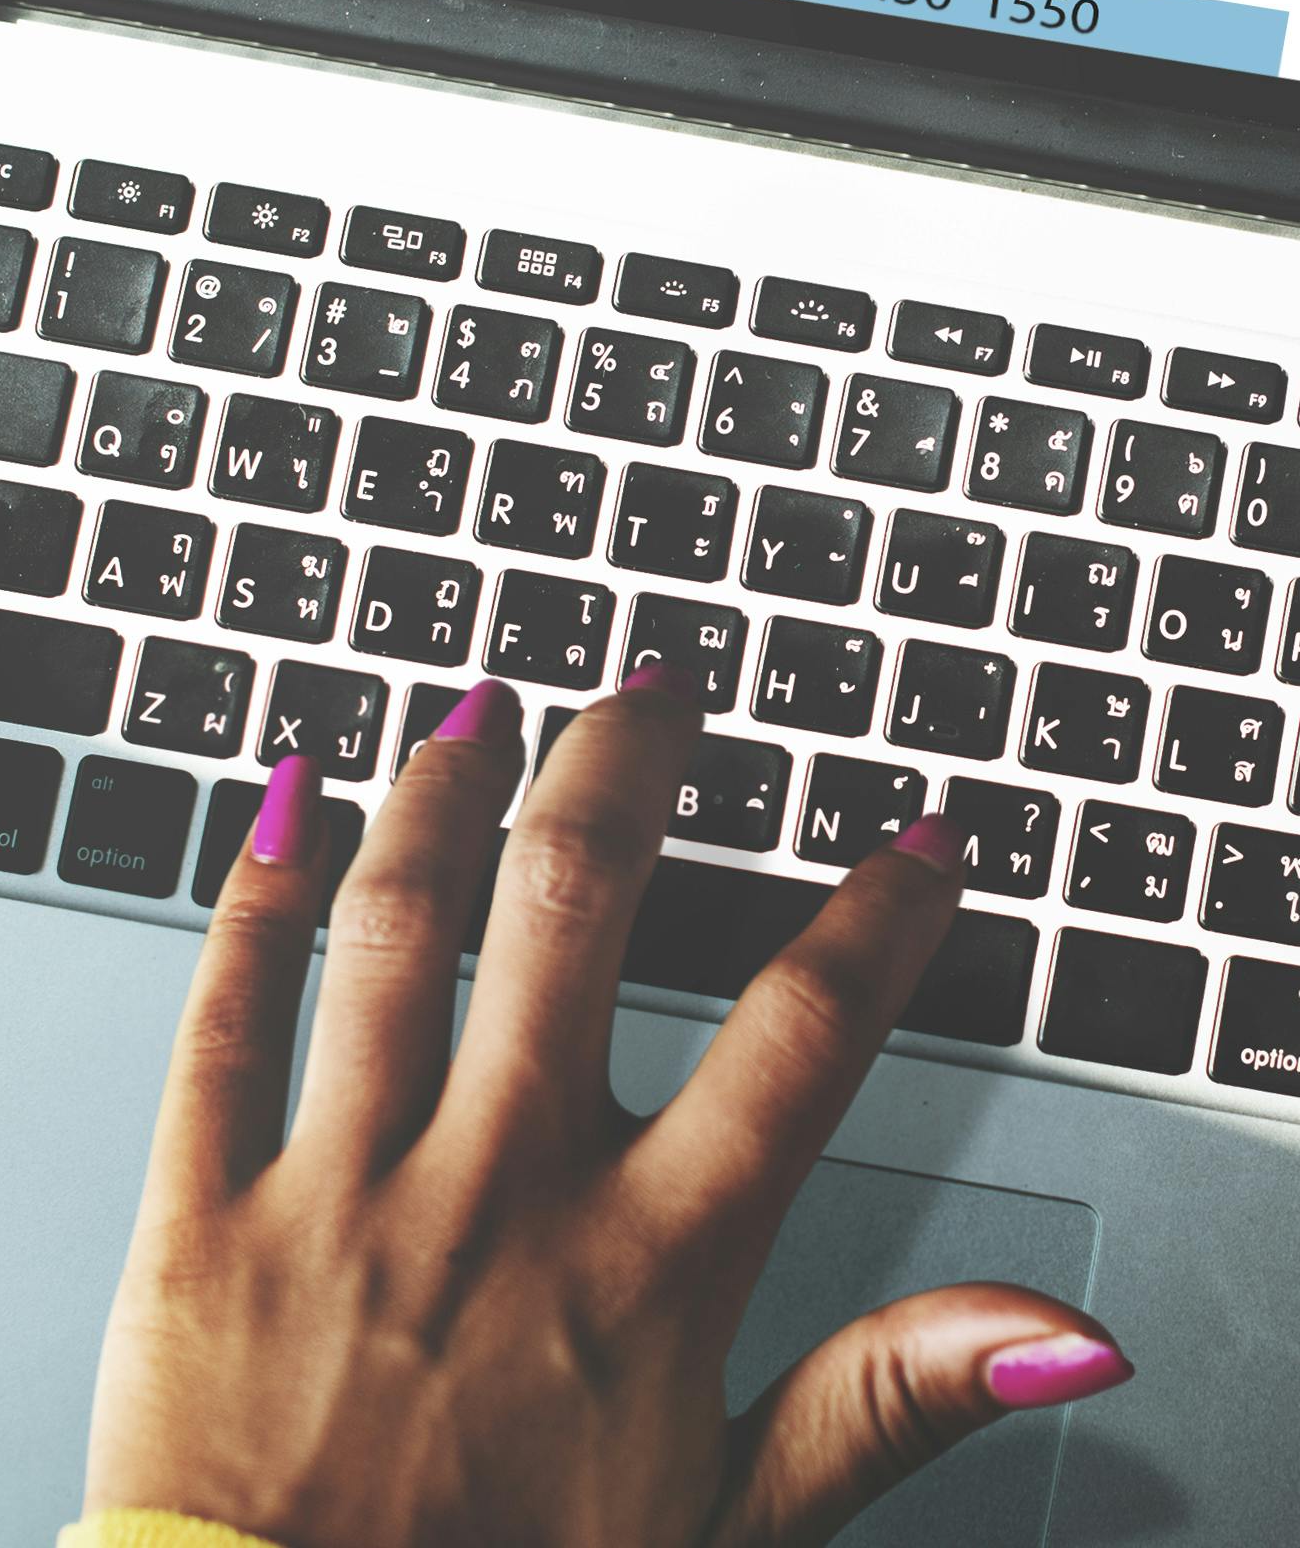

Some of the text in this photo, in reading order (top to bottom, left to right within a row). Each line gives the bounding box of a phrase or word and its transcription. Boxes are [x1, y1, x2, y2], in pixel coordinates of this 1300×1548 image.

[160, 205, 174, 219] F1
[292, 228, 310, 242] F2
[429, 251, 446, 265] F3
[565, 274, 581, 289] F4
[702, 298, 720, 312] F5
[838, 322, 855, 337] F6
[975, 347, 993, 361] F7
[1112, 370, 1129, 384] F8
[1249, 393, 1267, 407] F9
[94, 425, 121, 457] Q
[229, 446, 262, 479] W
[356, 470, 377, 500] E
[491, 493, 514, 524] R
[628, 516, 647, 546] T
[762, 539, 784, 569] Y
[92, 776, 113, 790] alt
[77, 847, 144, 870] option
